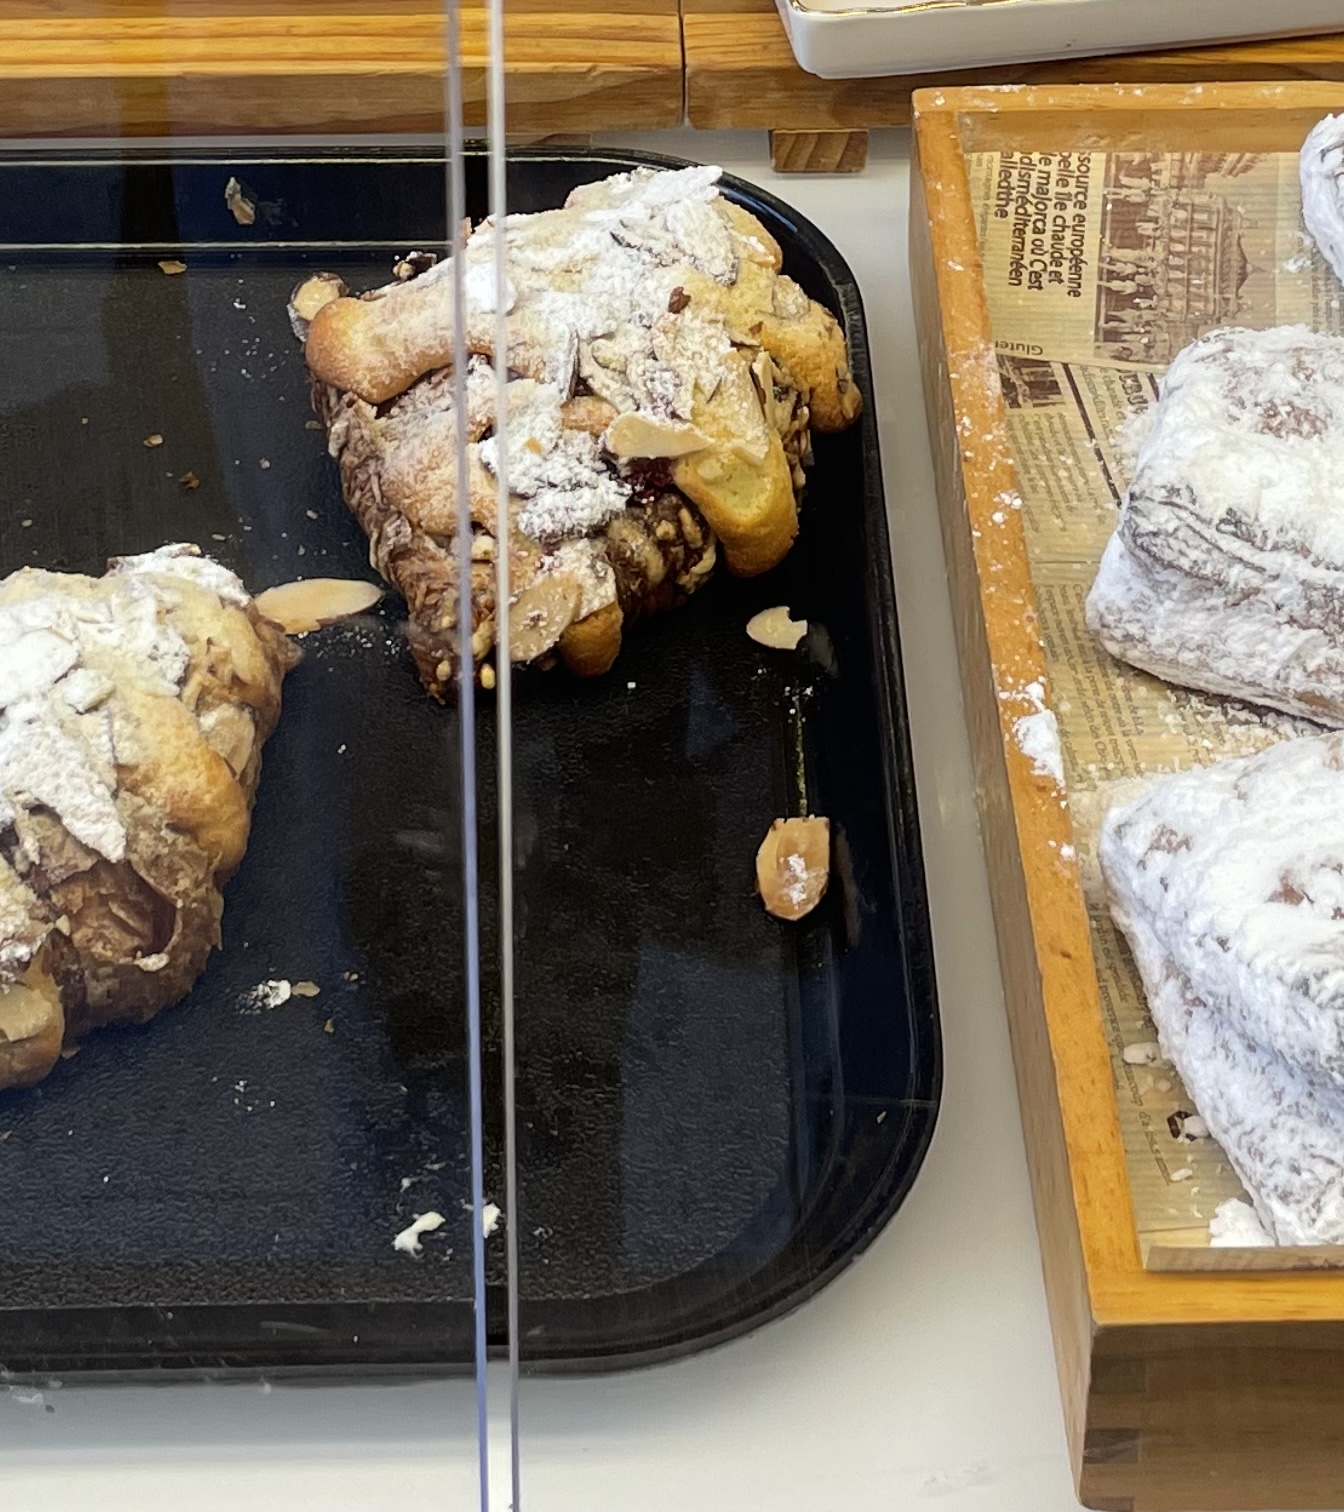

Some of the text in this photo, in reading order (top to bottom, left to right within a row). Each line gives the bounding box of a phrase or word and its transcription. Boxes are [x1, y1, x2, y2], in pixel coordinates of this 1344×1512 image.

[1030, 238, 1049, 256] où
[1049, 214, 1072, 268] chaude
[1067, 213, 1088, 298] européenne
[1048, 270, 1064, 284] et
